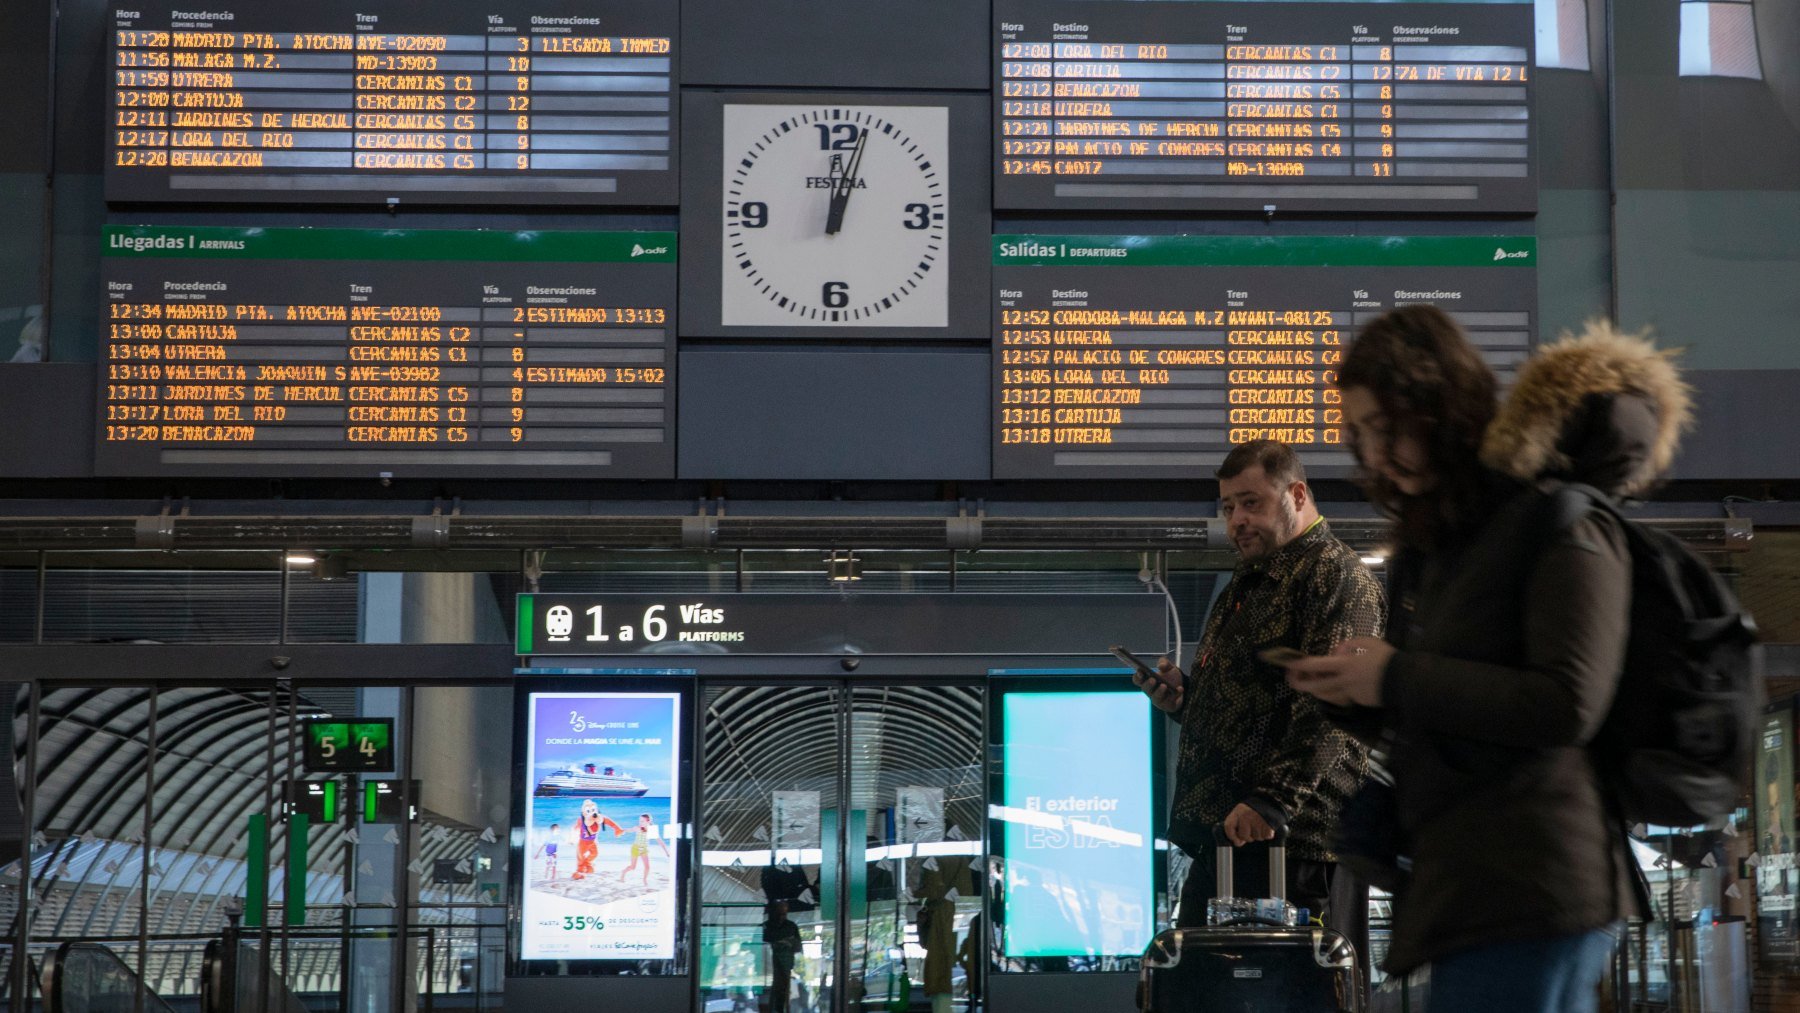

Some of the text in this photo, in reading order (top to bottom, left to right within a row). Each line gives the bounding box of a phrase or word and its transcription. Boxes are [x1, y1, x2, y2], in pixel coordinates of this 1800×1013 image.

[116, 10, 600, 25] Hora Procedencia Tren Vía Observaciones
[1001, 22, 1459, 35] Hora Destino Tren Vía Observaciones
[172, 33, 235, 48] MADRID
[243, 34, 279, 49] PTA.
[293, 35, 352, 50] ATOCHA
[543, 38, 611, 53] LLEGADA
[1003, 45, 1050, 59] 12:00
[119, 52, 169, 67] 11:56
[173, 52, 234, 68] MALAGA
[508, 57, 529, 71] 10
[117, 72, 472, 91] 11:59 UTRERA CERCANIAS C1
[1004, 83, 1050, 98] 12:12
[1005, 102, 1052, 117] 12:18
[117, 111, 352, 128] 12:11 JARDINES DE HERCUL
[814, 124, 859, 150] 12
[117, 151, 263, 168] 12:20 BENACAZON
[1004, 161, 1051, 174] 12:45
[805, 177, 867, 189] FESTNA
[741, 201, 768, 229] 9
[903, 203, 930, 230] 3
[110, 234, 245, 251] Llegadas ARRIVALS
[1000, 243, 1127, 258] Salidas DEPARTURES
[108, 281, 597, 295] Hora Procedencia Tren Vía Observaciones
[822, 281, 849, 308] 6
[1000, 289, 1461, 299] Hora Destino Tren Vía Observaciones
[112, 304, 162, 318] 12:34
[166, 304, 228, 319] MADRID
[236, 305, 273, 320] PTA.
[287, 306, 347, 320] ATOCHA
[527, 308, 607, 322] ESTIMADO
[616, 309, 665, 323] 13:13
[1003, 310, 1050, 325] 12:52
[165, 324, 237, 340] CARTUJA
[351, 326, 441, 341] CERCANIAS
[450, 327, 470, 342] C2
[1003, 329, 1340, 346] 12:53 UTRERA CERCANIAS C1
[1003, 350, 1050, 365] 12:57
[1053, 350, 1121, 364] PALACIO
[1129, 350, 1149, 364] DE
[1157, 350, 1226, 364] CONGRES
[1228, 350, 1314, 364] CERCANIAS
[110, 365, 161, 380] 13:10
[165, 365, 246, 380] VALENCIA
[256, 366, 326, 381] JOAQUIN
[526, 368, 606, 382] ESTIMADO
[616, 368, 664, 383] 15:02
[1053, 369, 1094, 385] LORA
[1101, 369, 1130, 385] DEL
[1139, 369, 1169, 384] RIO
[109, 384, 344, 400] 13:11 JARDINES DE HERCUL
[1002, 387, 1343, 406] 13:12 BENACAZON C5
[108, 405, 466, 421] 13:17 LORA DEL RIO CERCANIAS C1
[1004, 407, 1343, 425] 13:16 CARTUJA CERCANIAS C2
[1002, 427, 1341, 444] 13:18 UTRERA C1
[585, 603, 724, 642] 1 a 6 Vías
[679, 631, 745, 642] PLATFORMS
[321, 736, 335, 758] 5
[359, 736, 376, 757] 4
[1026, 797, 1118, 812] El exterior
[563, 916, 604, 930] 35%
